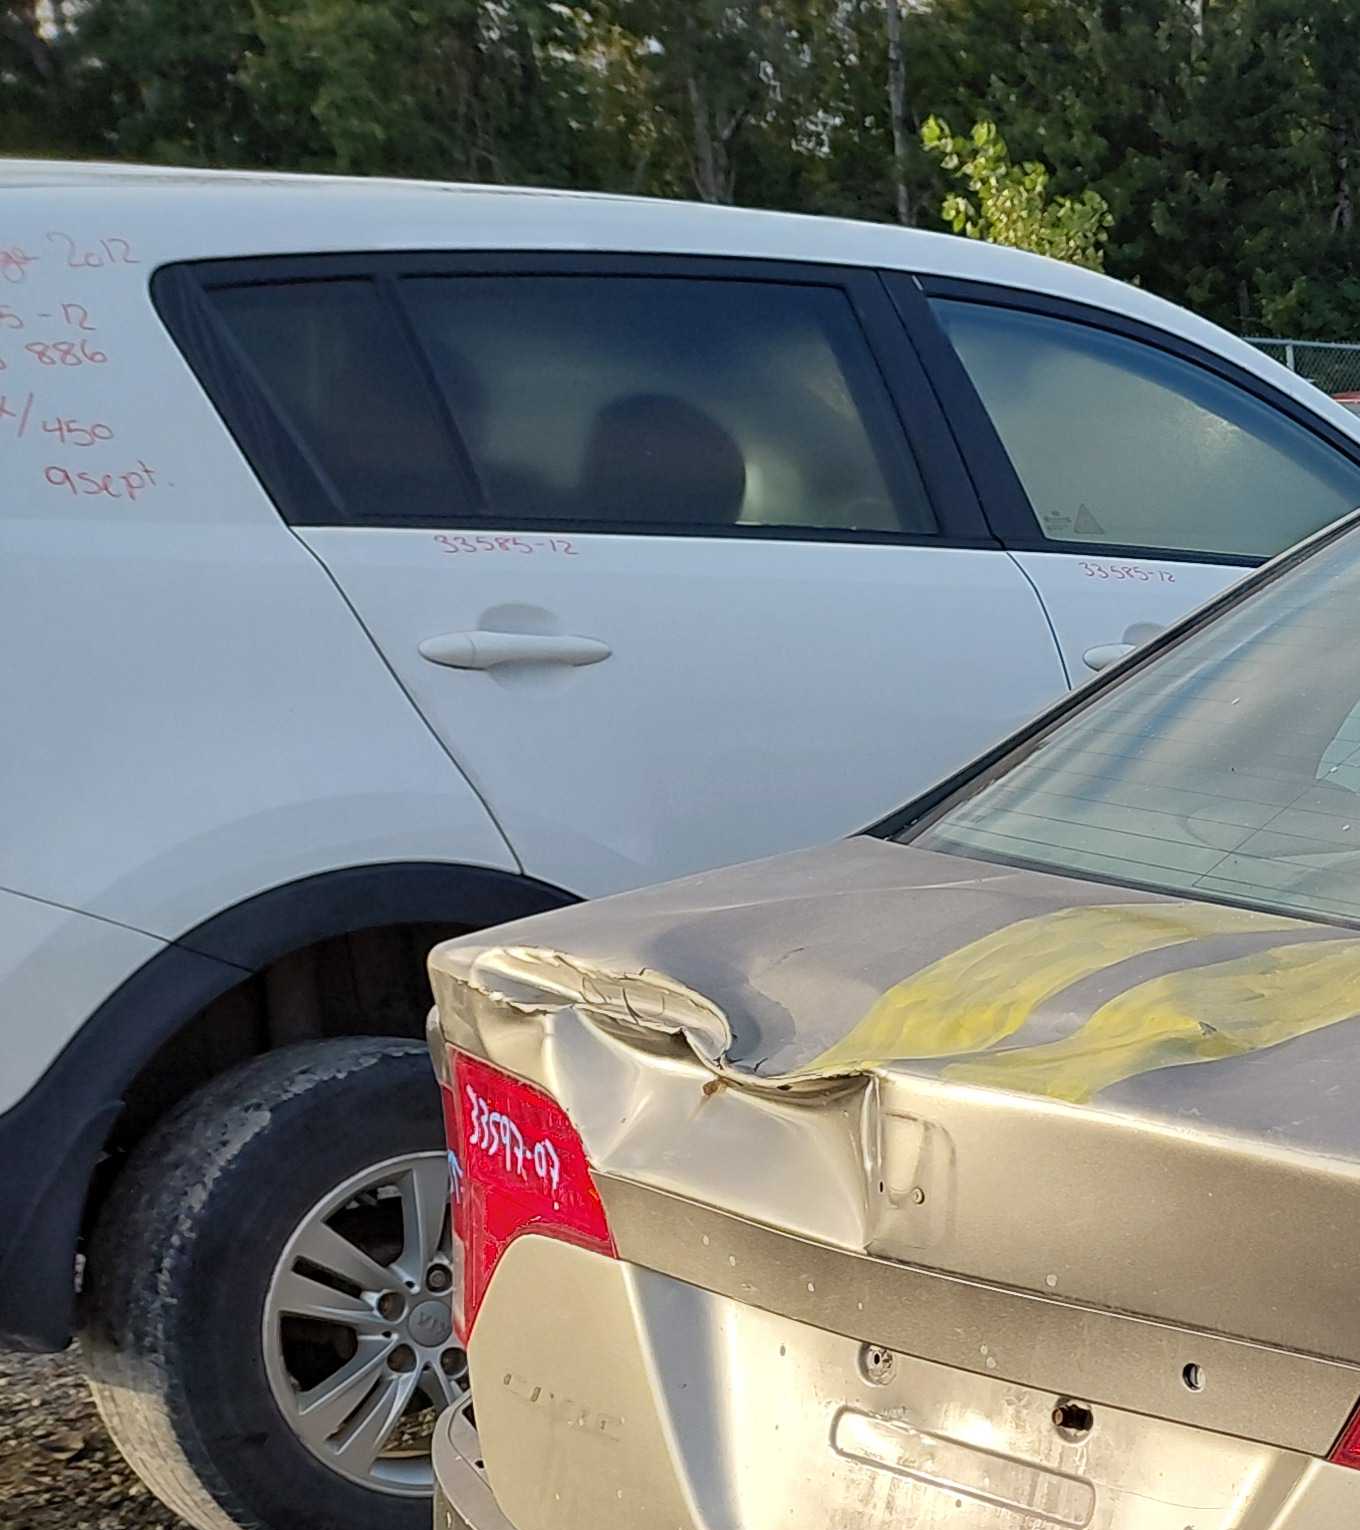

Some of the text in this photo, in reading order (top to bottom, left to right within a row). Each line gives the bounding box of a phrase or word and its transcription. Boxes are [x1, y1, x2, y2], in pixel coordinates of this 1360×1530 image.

[46, 231, 141, 267] 2012
[25, 338, 108, 366] 886
[42, 417, 114, 446] 450
[433, 534, 579, 555] 33585-12
[465, 1083, 561, 1190] 33597-07
